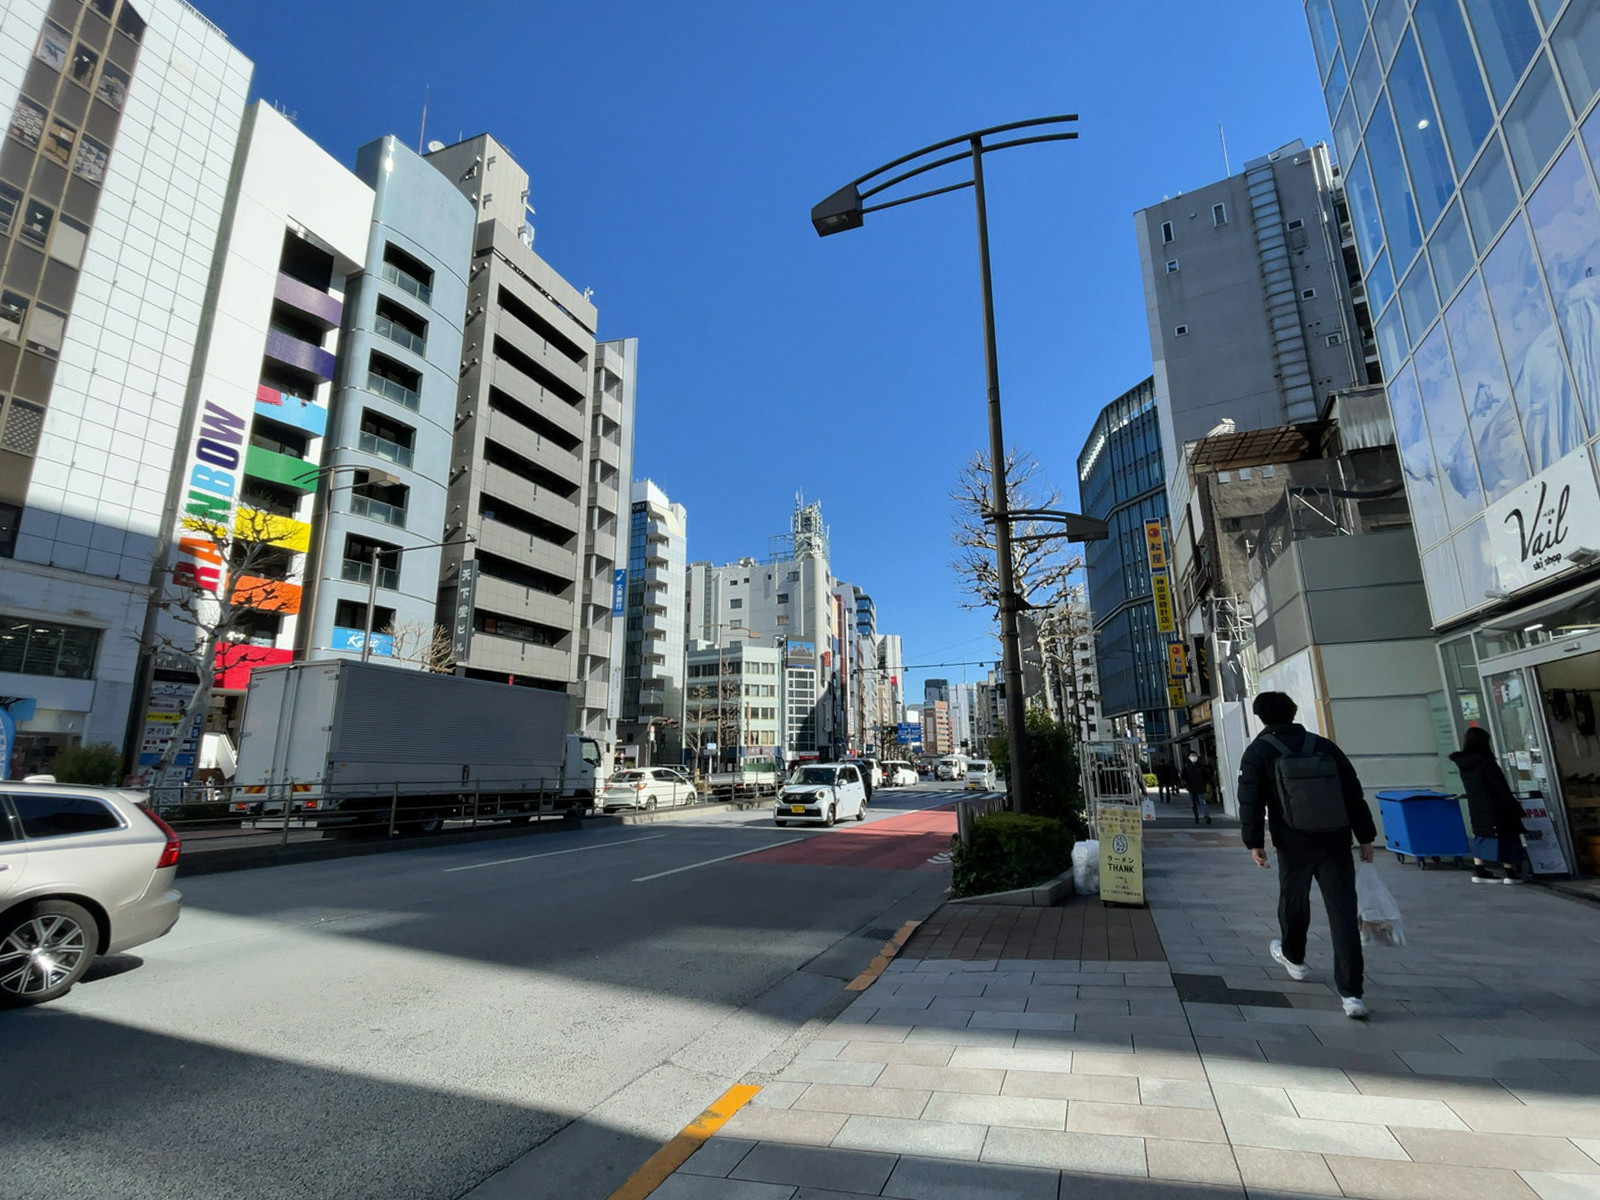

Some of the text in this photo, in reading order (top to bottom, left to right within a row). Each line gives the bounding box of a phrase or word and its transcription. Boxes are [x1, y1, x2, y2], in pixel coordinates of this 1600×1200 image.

[172, 400, 246, 592] RAINBOW
[1504, 481, 1569, 563] Vail
[1150, 542, 1163, 564] 松屋
[1533, 553, 1562, 571] ski shop
[456, 568, 471, 652] 天下堂ビル
[1107, 856, 1134, 864] ラーメン
[1107, 864, 1135, 874] THANK
